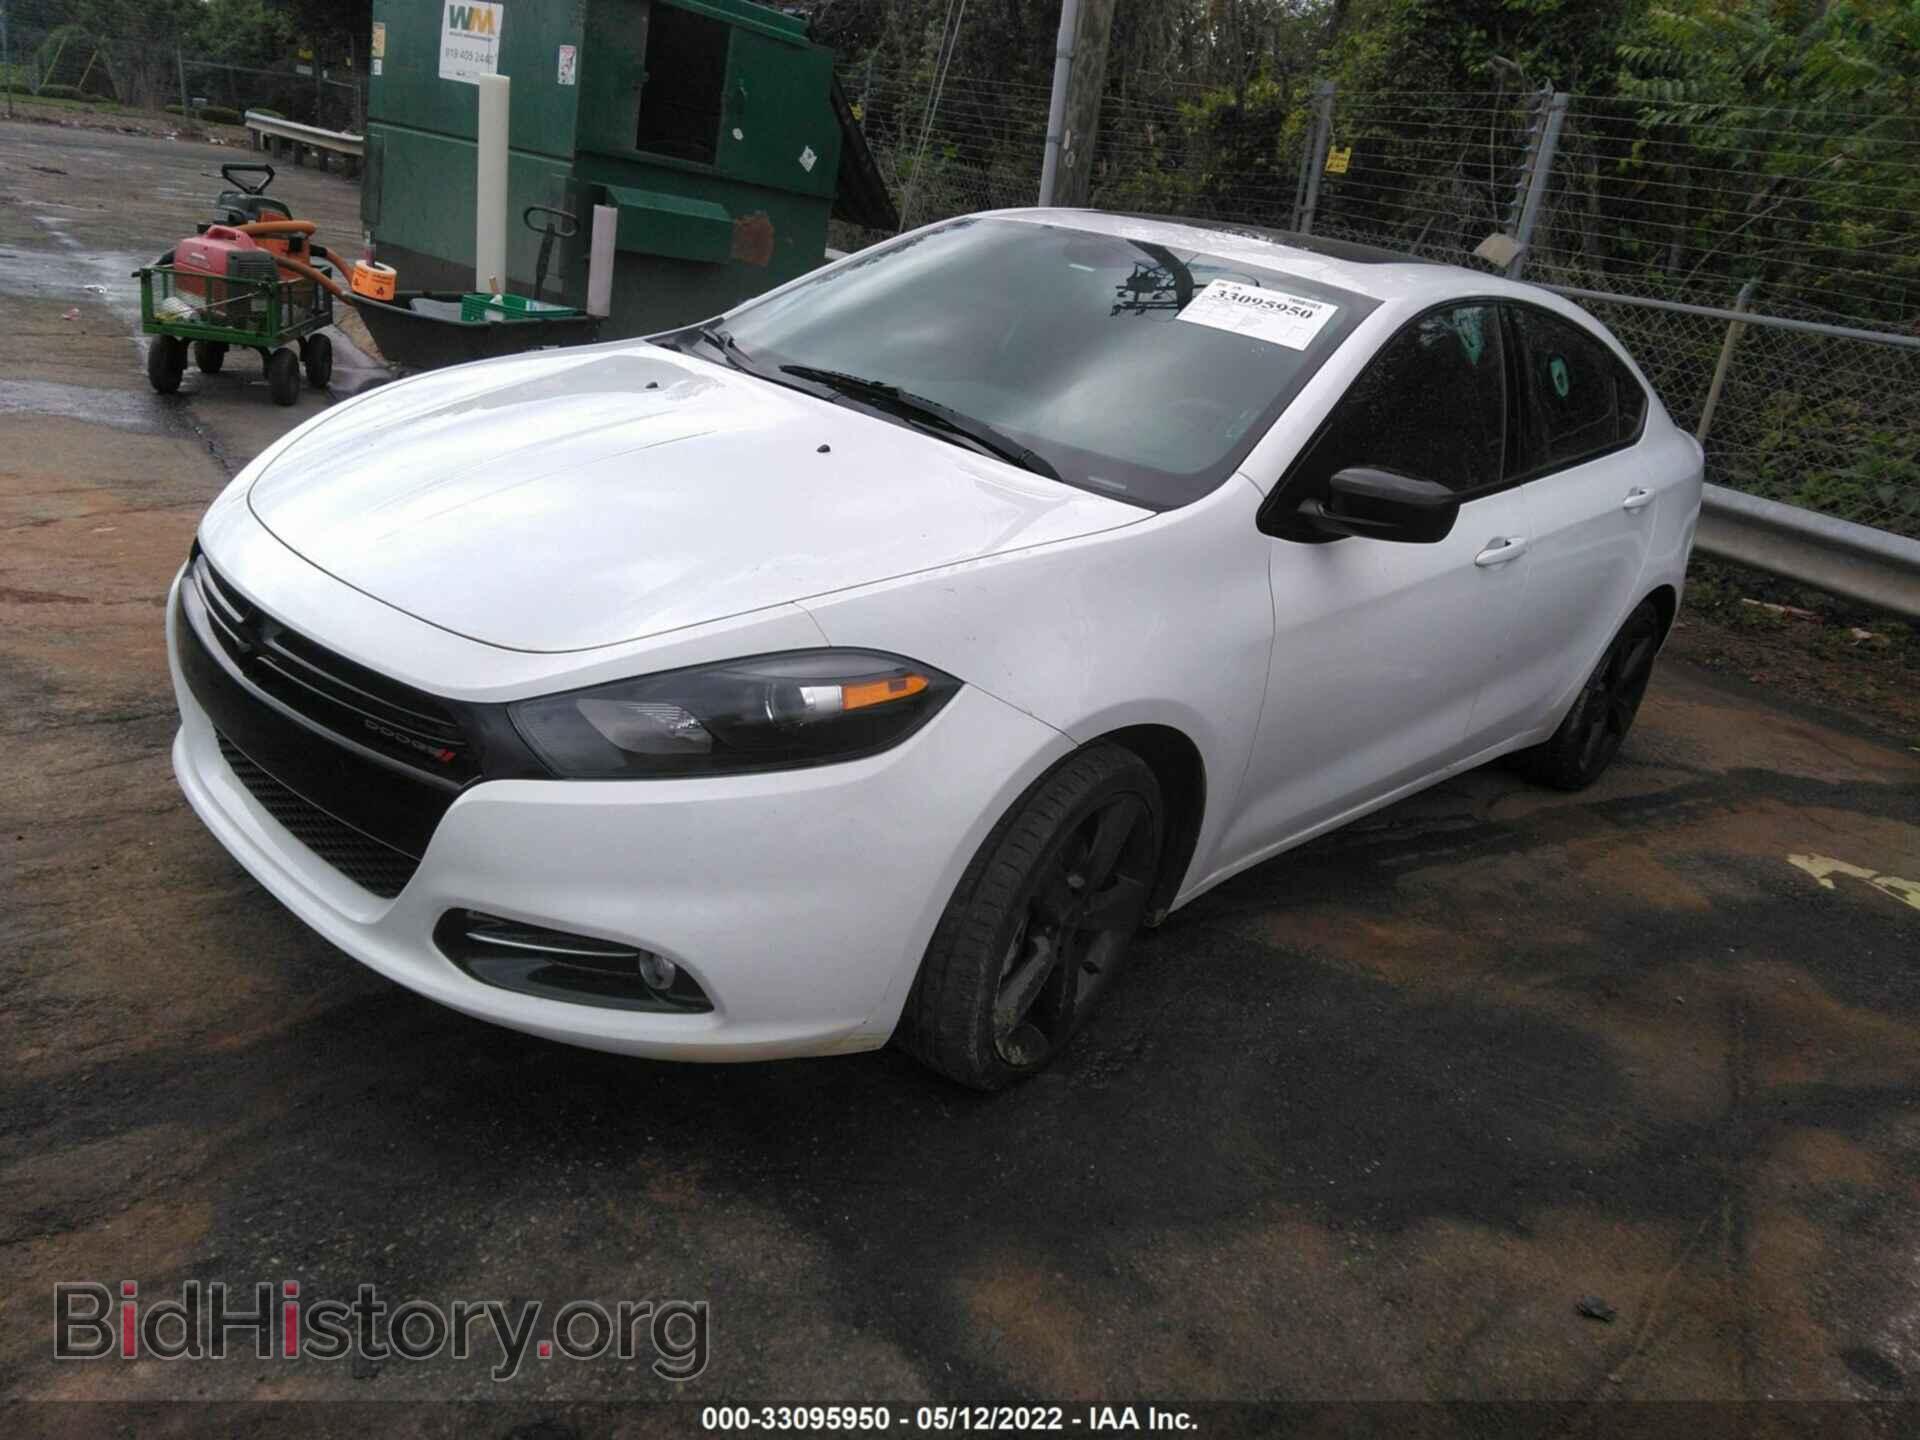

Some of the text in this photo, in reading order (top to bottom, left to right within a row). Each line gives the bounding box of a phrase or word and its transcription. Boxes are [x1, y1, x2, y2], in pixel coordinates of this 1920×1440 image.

[449, 4, 496, 36] WM
[1208, 289, 1314, 320] 33095950
[365, 719, 439, 757] DODGE
